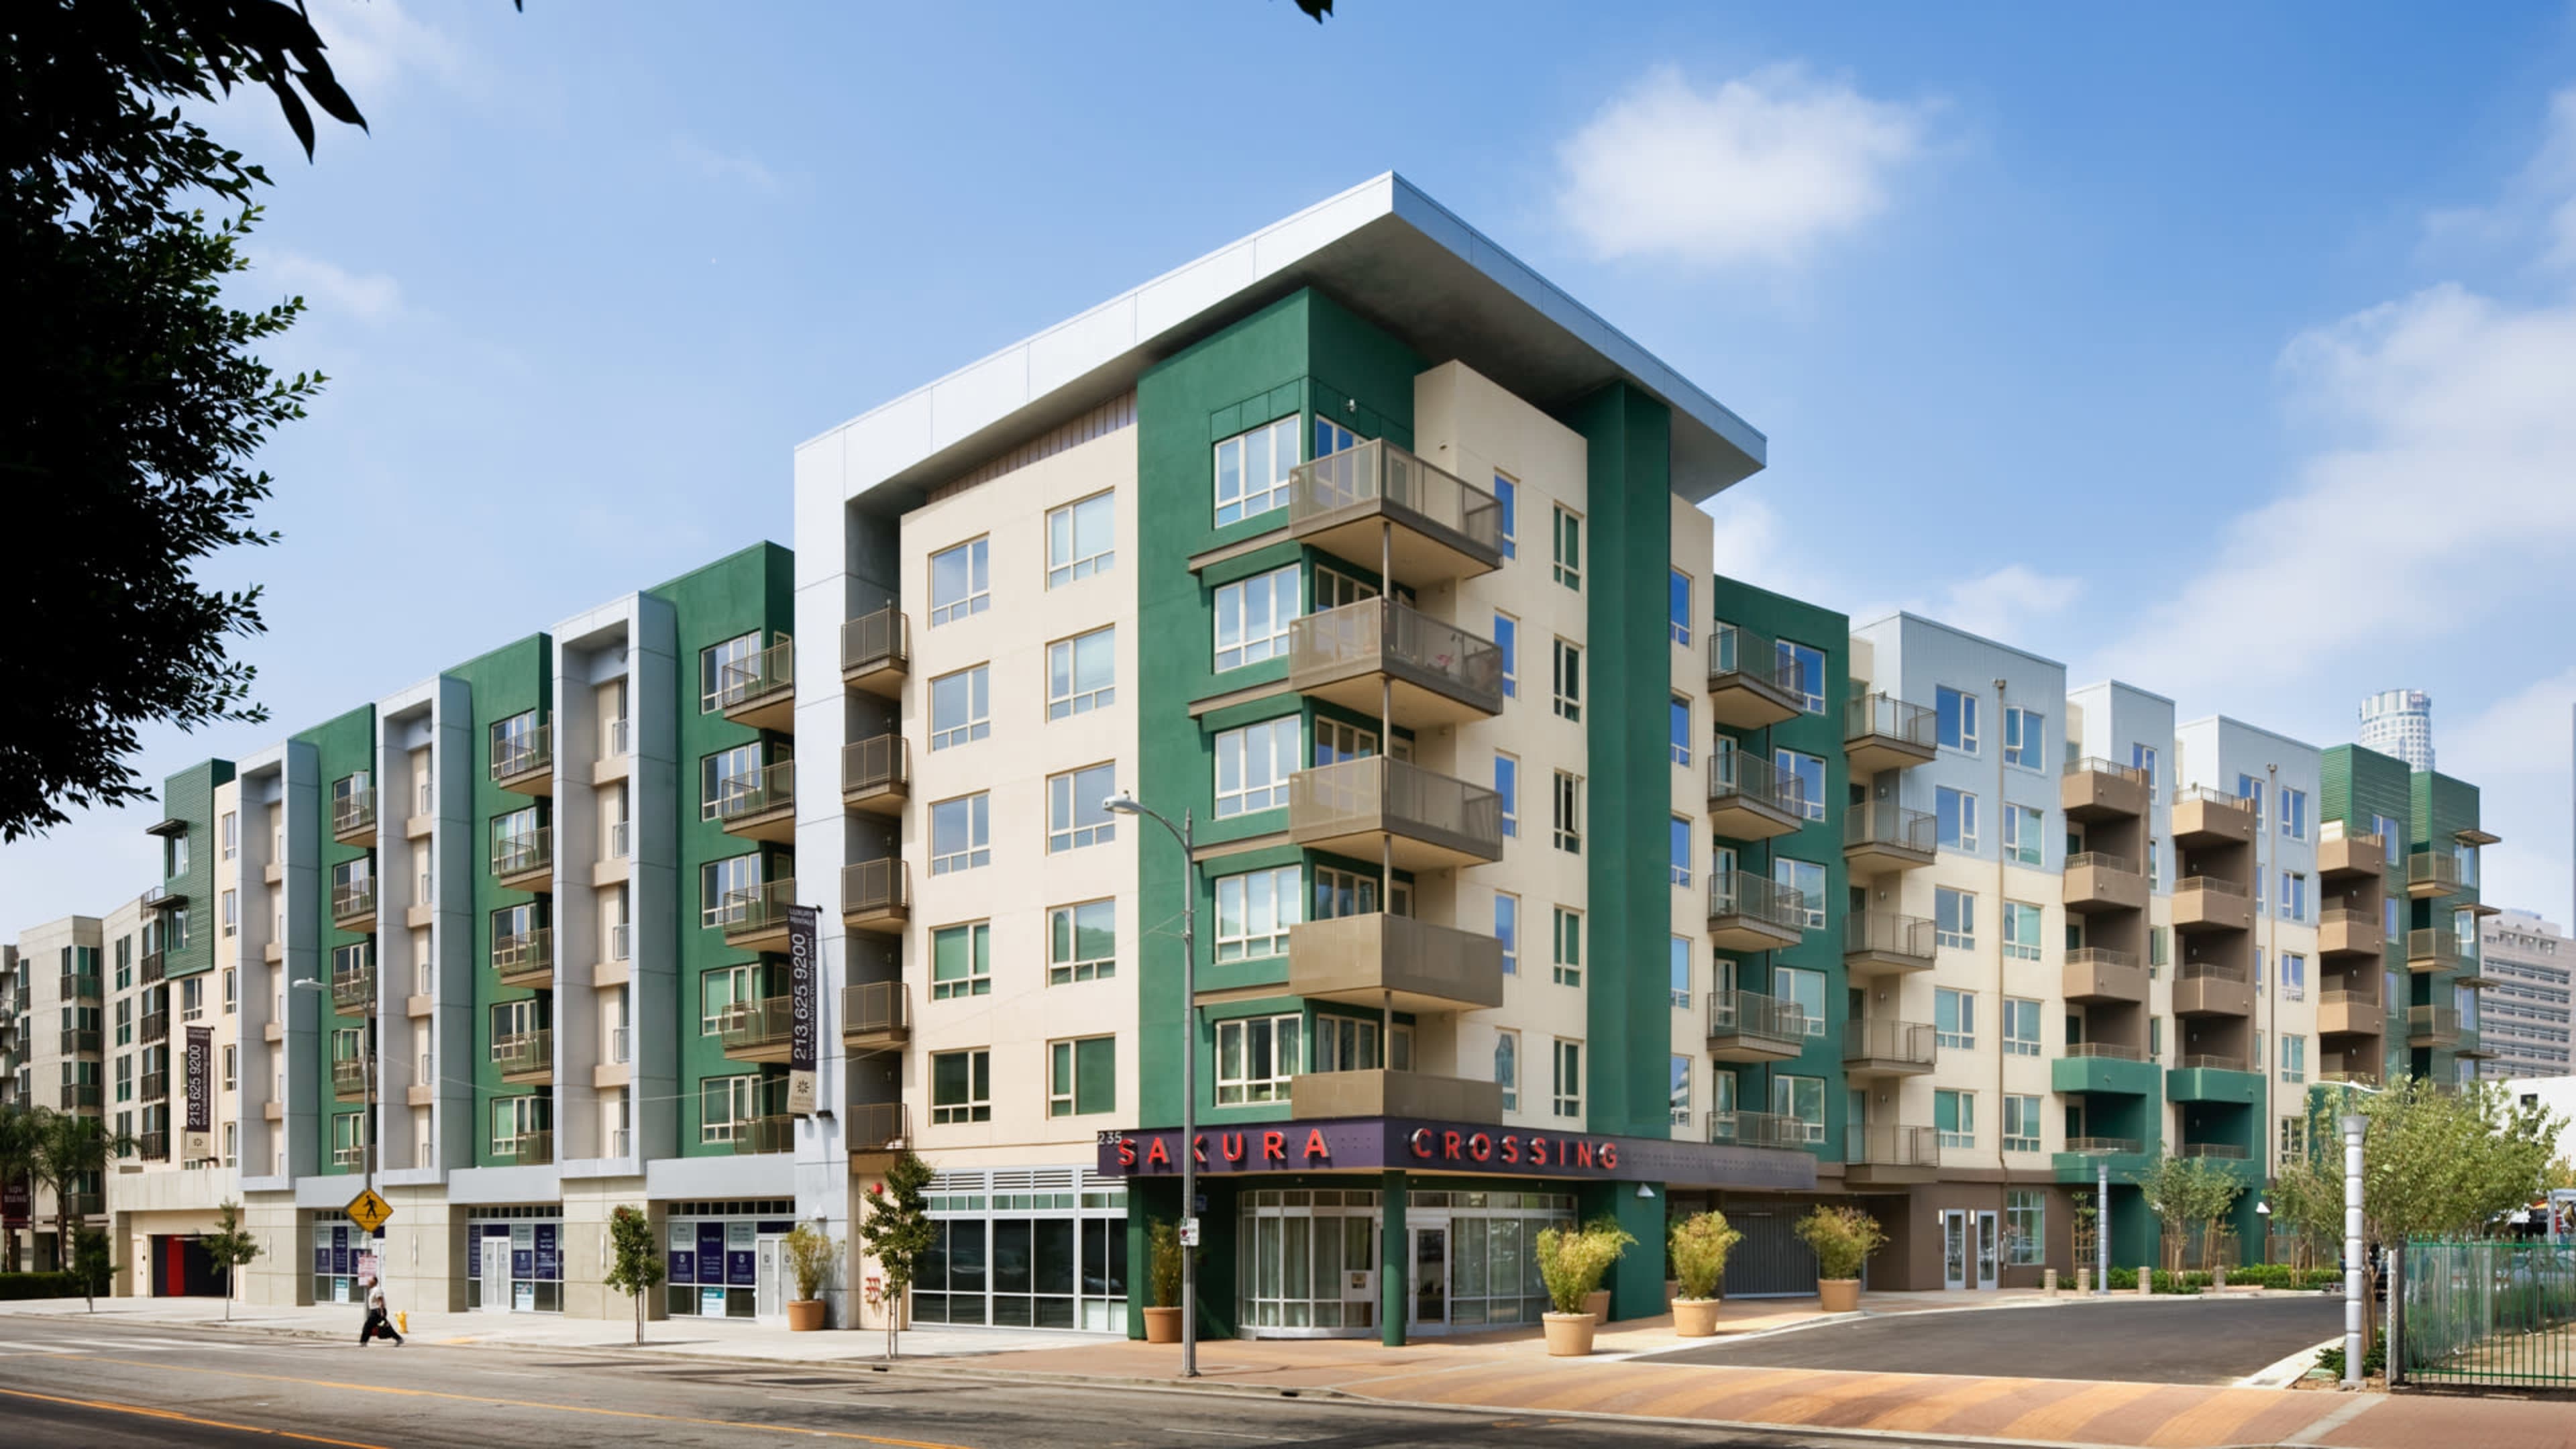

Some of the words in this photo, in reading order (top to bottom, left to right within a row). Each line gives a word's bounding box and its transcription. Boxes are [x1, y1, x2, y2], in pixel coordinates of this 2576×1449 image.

[792, 933, 808, 979] 9200
[794, 985, 808, 1019] 625
[794, 1024, 808, 1060] 213
[189, 1044, 201, 1074] 9200
[189, 1077, 201, 1100] 625
[189, 1102, 201, 1126] 213
[1097, 1130, 1122, 1144] 235
[1411, 1128, 1617, 1169] CROSSING
